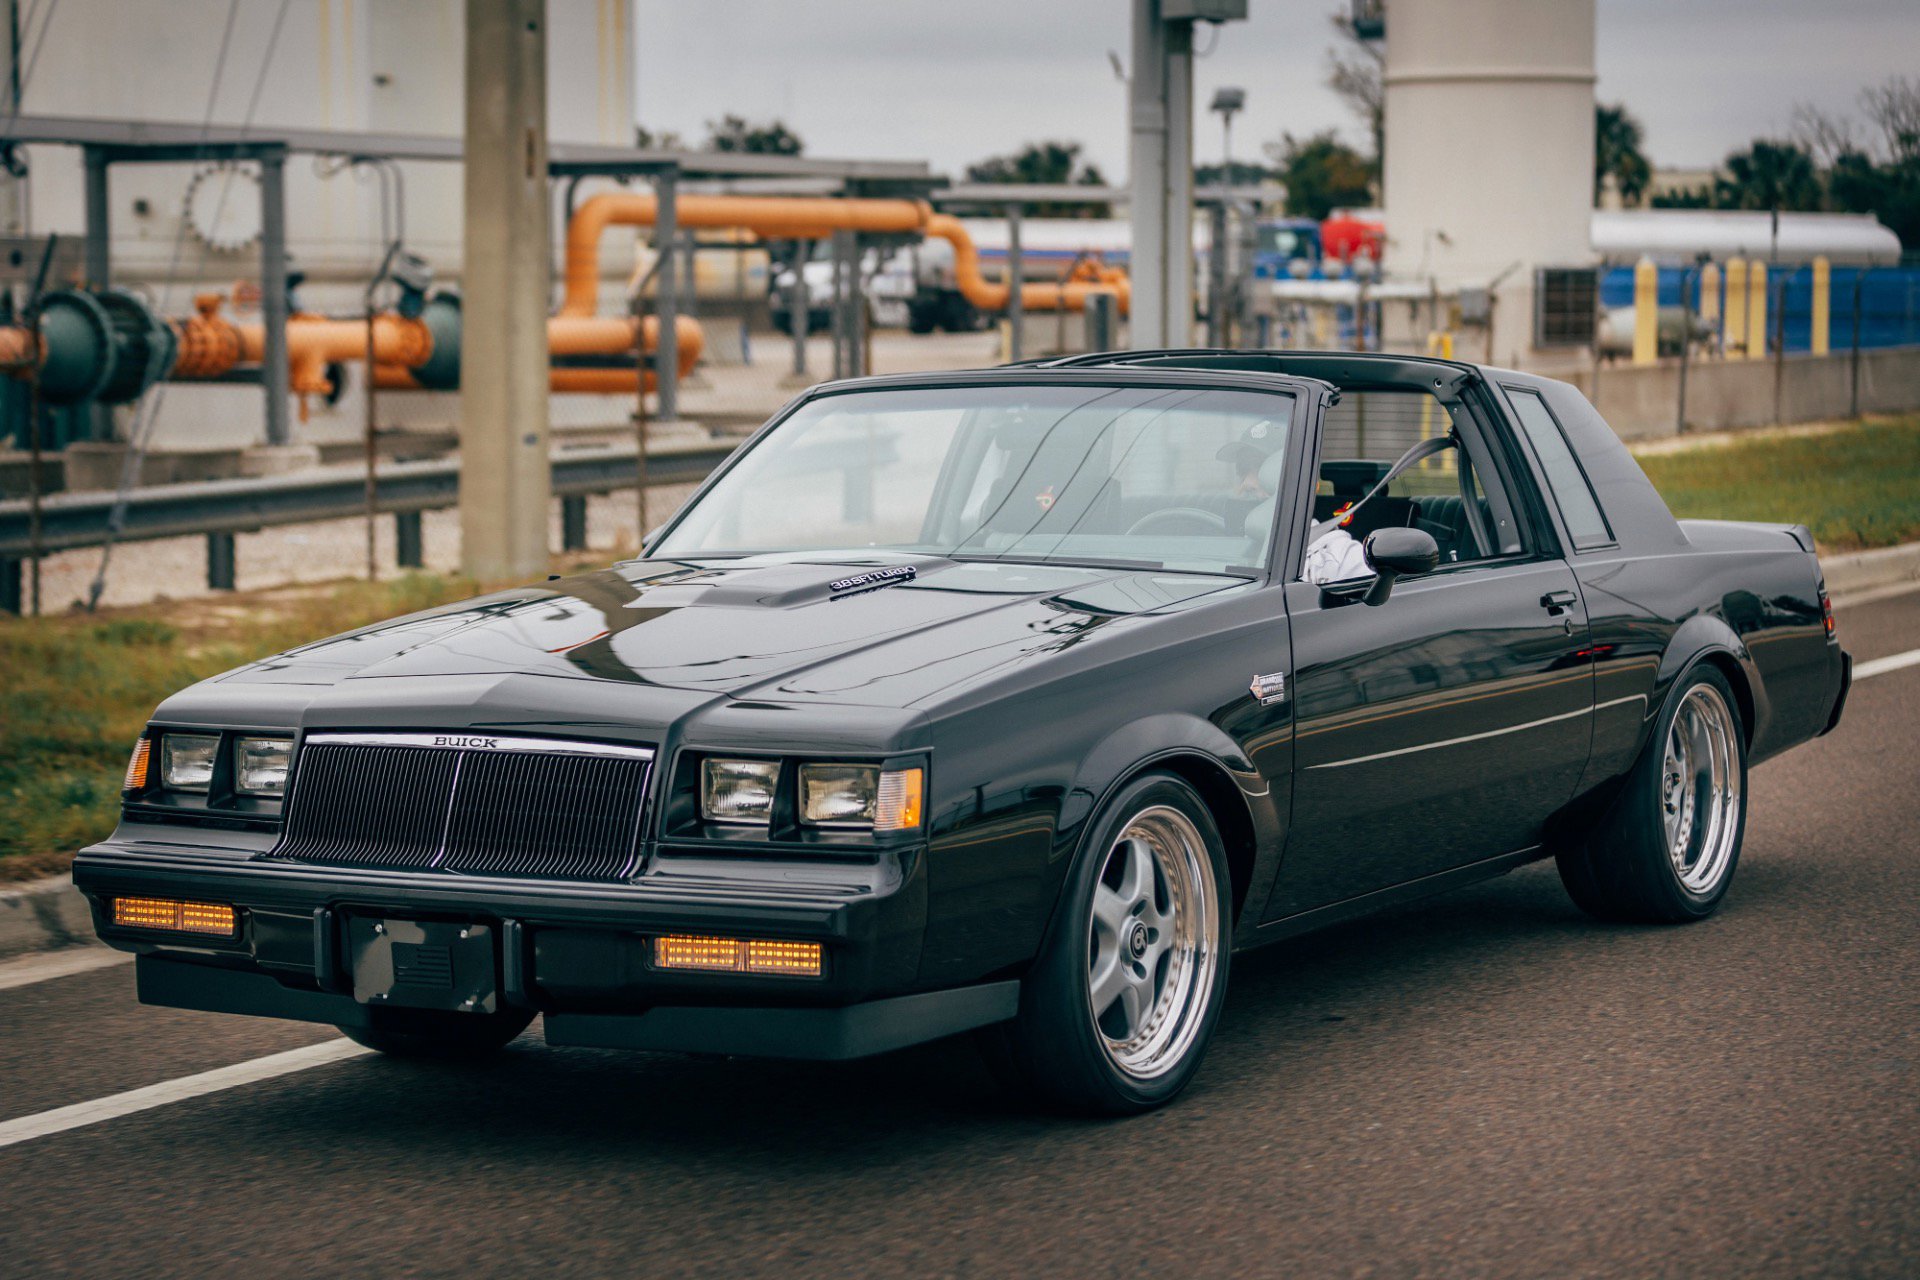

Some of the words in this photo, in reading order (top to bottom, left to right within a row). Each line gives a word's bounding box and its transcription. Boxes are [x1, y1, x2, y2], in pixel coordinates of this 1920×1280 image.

[851, 573, 873, 586] SFI
[870, 565, 917, 580] TURBO
[432, 736, 498, 748] BUICK
